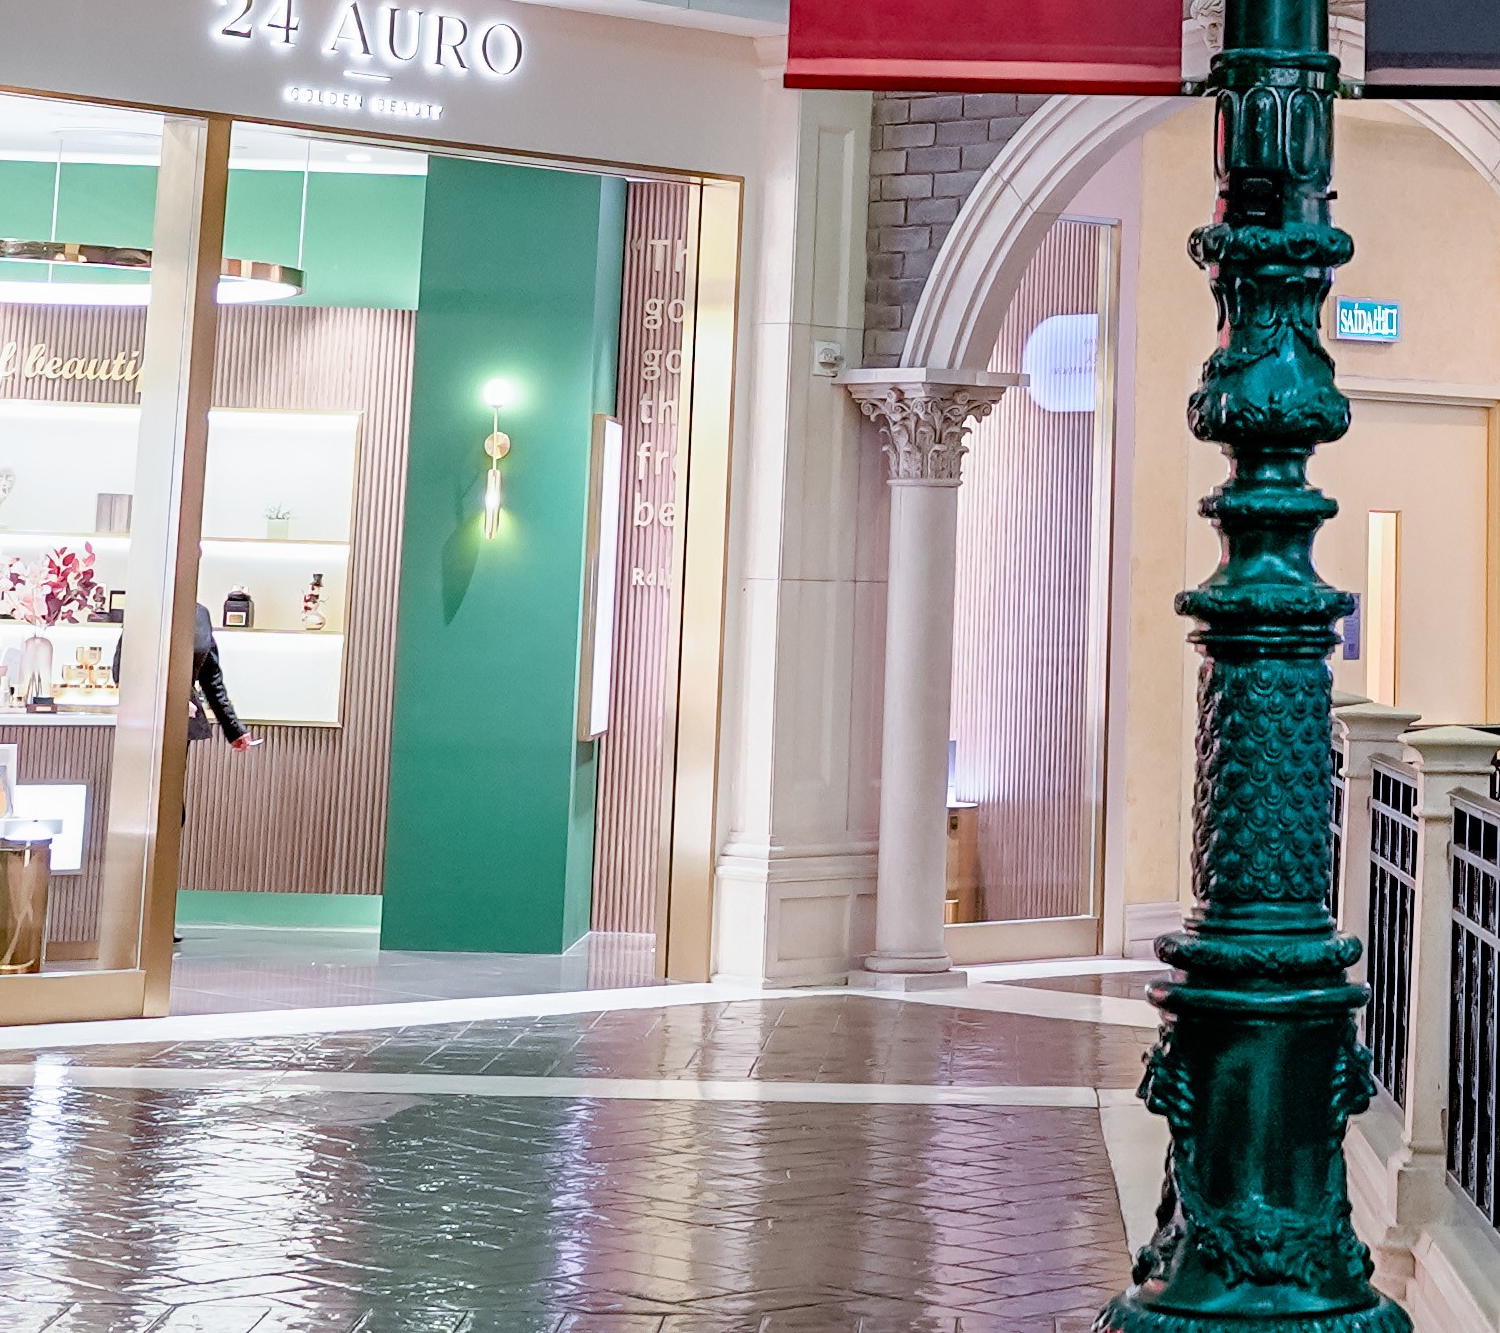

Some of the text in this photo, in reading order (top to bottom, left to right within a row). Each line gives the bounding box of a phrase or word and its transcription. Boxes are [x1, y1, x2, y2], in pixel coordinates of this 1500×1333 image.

[323, 0, 525, 77] AURO
[285, 86, 444, 121] GOLDEN BEAUTY
[1340, 302, 1398, 336] SAÍDA 出口
